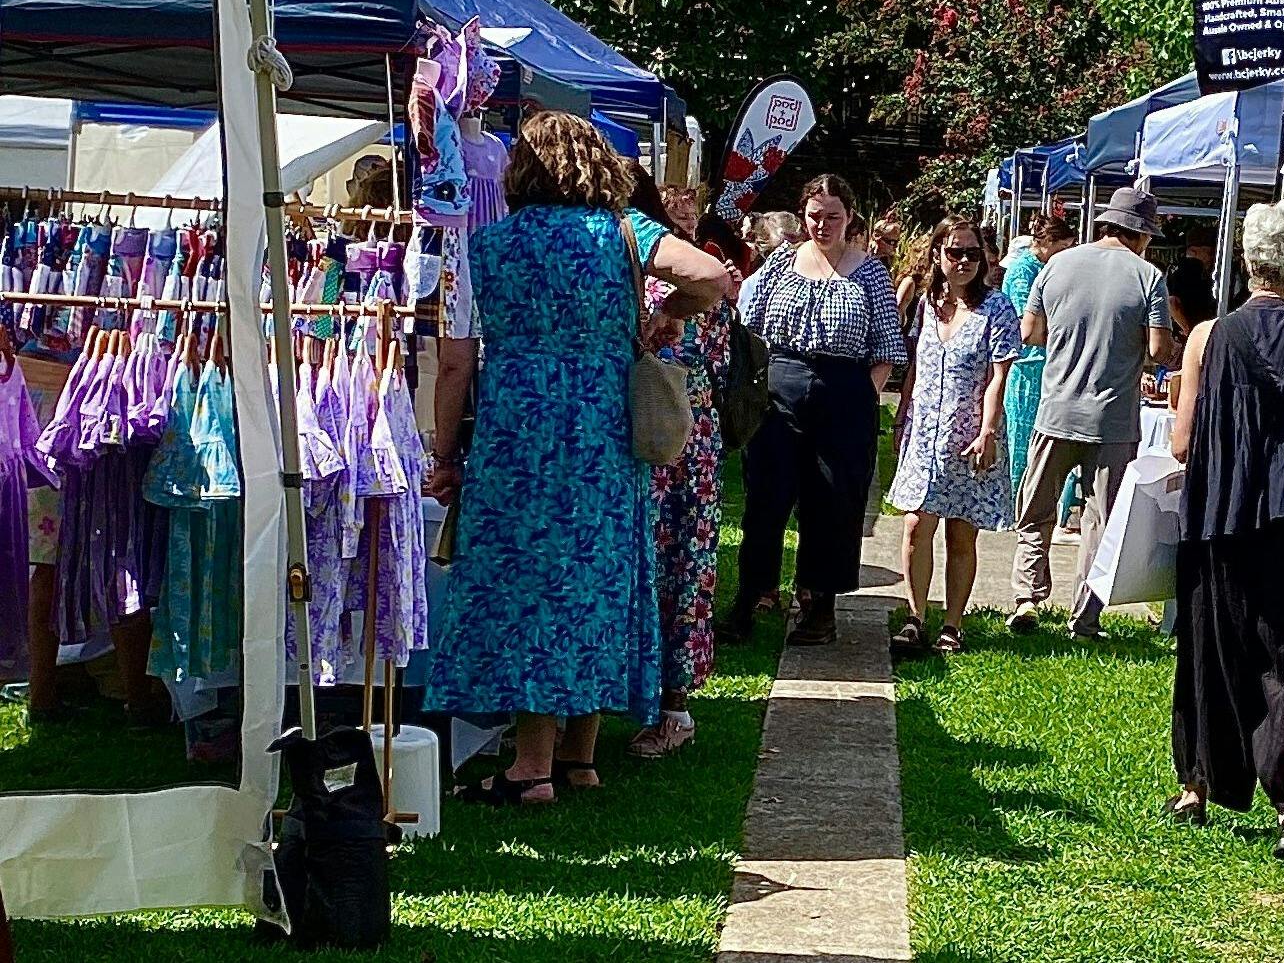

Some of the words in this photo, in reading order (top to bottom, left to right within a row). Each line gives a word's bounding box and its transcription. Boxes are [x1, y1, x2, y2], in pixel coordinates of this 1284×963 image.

[1229, 20, 1262, 32] Owned
[1264, 20, 1272, 29] &
[772, 99, 798, 112] pod
[769, 114, 795, 129] pod
